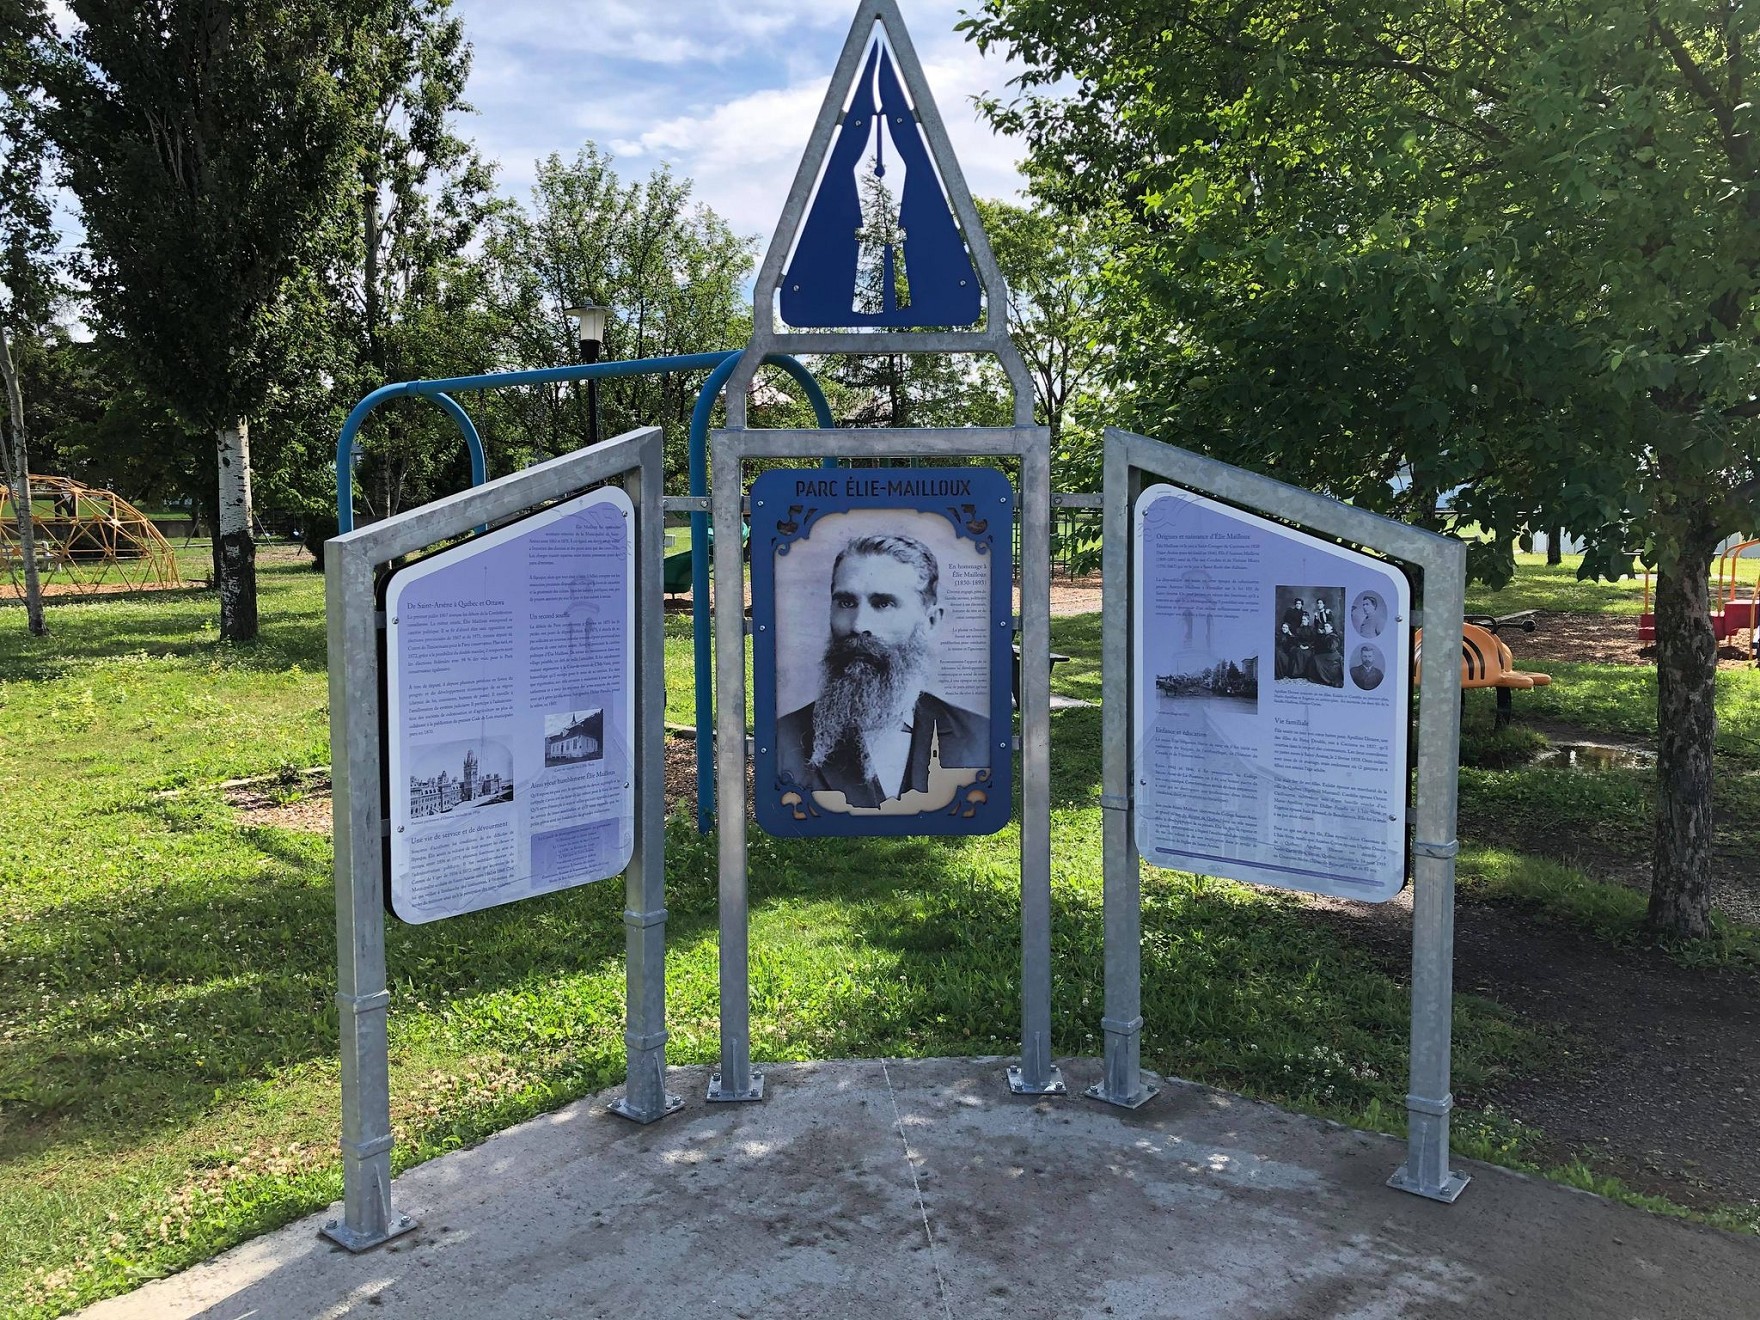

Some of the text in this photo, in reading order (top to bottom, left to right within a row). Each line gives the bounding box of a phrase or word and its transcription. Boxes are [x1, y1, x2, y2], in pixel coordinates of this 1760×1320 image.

[796, 476, 971, 497] PARC ÉLIE-MAILLOUX
[952, 570, 963, 578] Élie
[407, 602, 416, 610] De
[417, 601, 453, 609] Saint-Arsène
[458, 600, 479, 609] Québec
[538, 612, 555, 620] second
[1274, 717, 1309, 727] Vie familiale
[586, 771, 596, 779] Élie
[596, 770, 616, 778] Mailloux
[410, 837, 423, 845] Une
[434, 833, 441, 841] de
[442, 831, 461, 839] service
[468, 826, 476, 834] de
